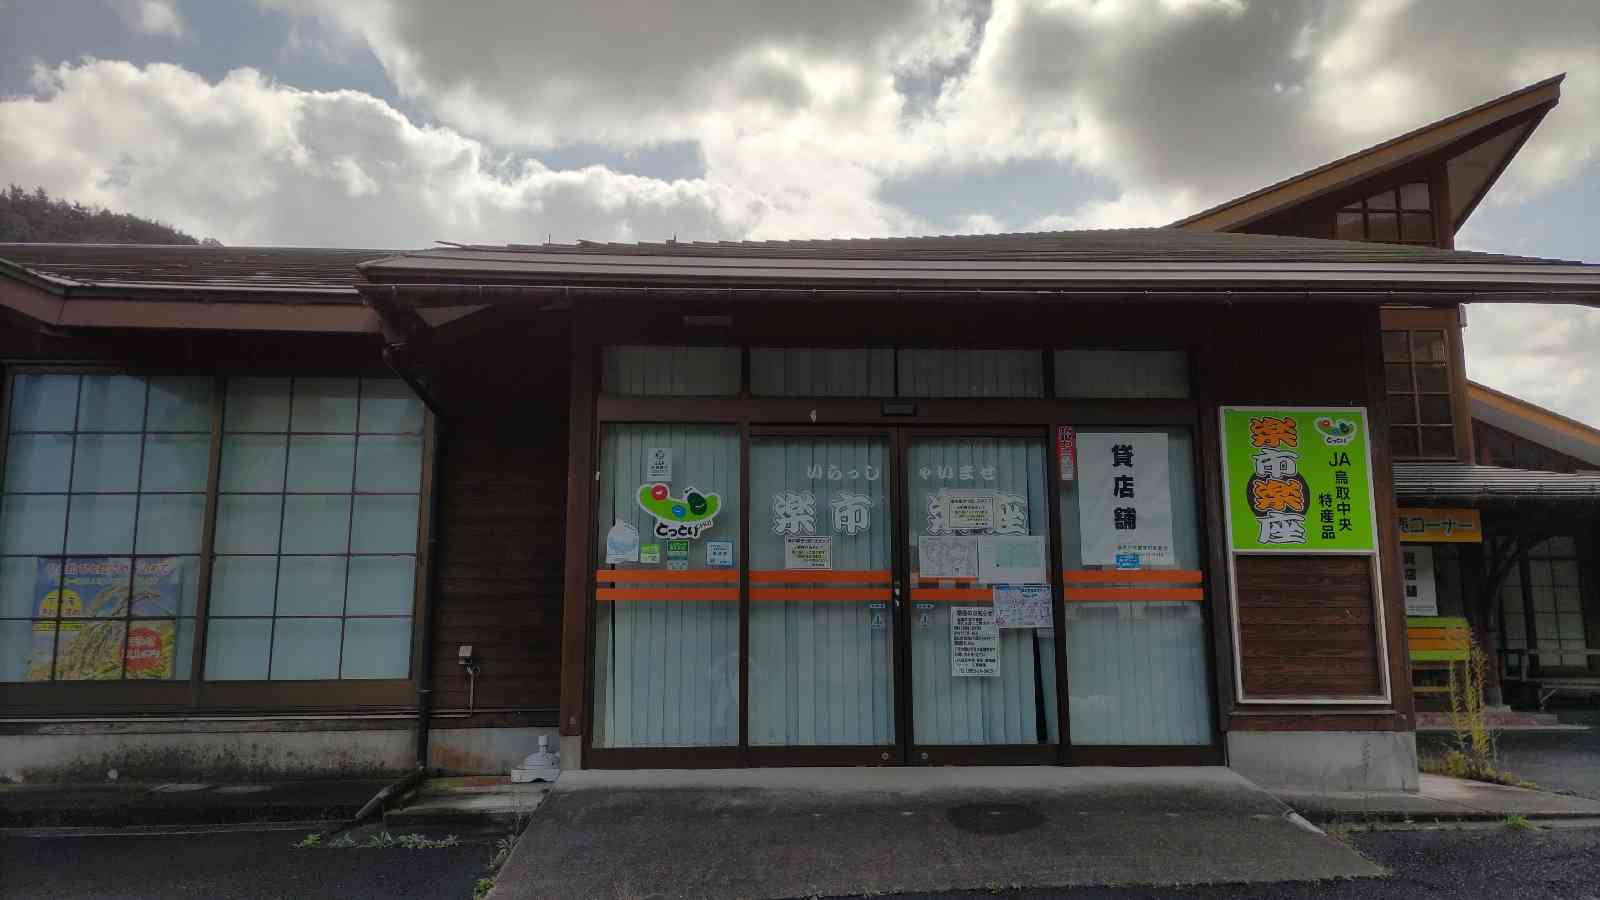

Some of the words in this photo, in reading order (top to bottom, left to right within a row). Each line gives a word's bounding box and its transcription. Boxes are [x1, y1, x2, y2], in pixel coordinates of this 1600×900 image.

[1111, 444, 1136, 530] 貸店舗
[1250, 416, 1306, 544] 楽市楽座
[656, 523, 699, 537] とっとり
[1318, 492, 1335, 539] 特産品
